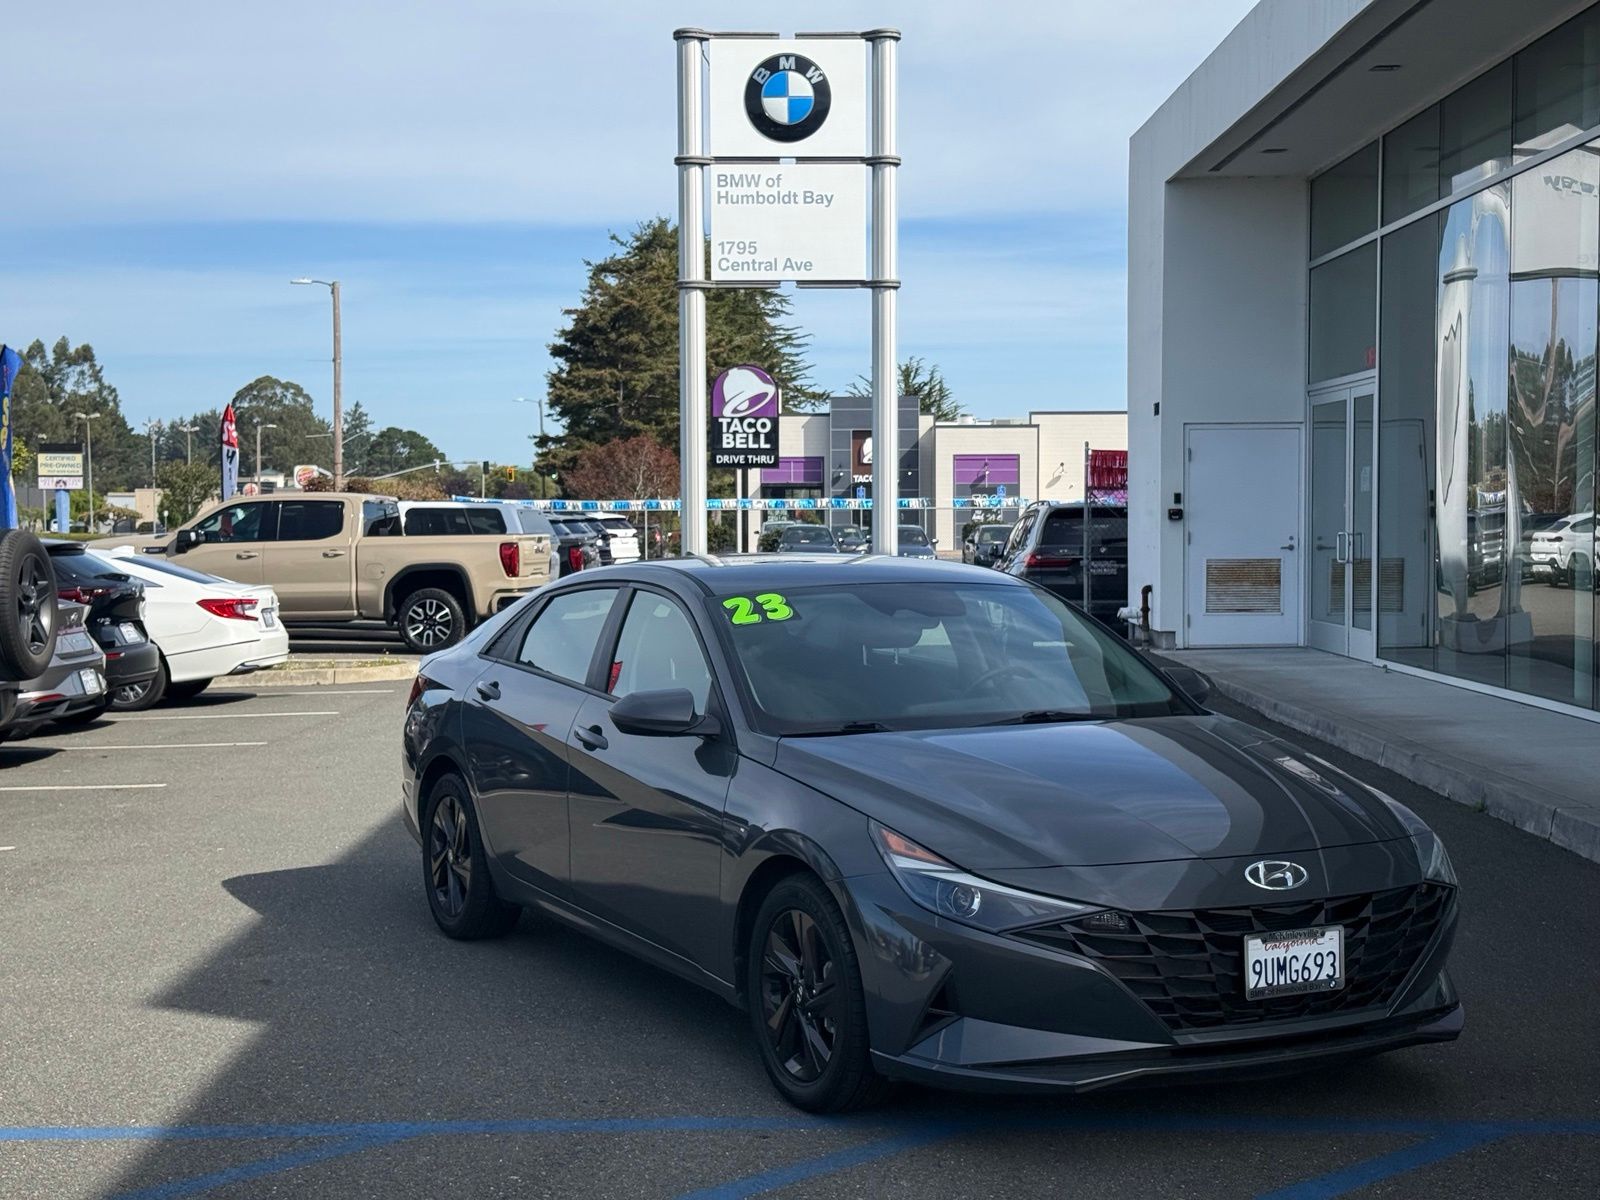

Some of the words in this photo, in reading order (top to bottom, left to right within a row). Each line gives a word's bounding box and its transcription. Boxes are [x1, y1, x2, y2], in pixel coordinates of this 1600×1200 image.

[753, 56, 824, 85] BMW
[716, 174, 761, 188] BMW
[765, 174, 782, 188] of
[716, 190, 799, 205] Humboldt
[803, 191, 834, 207] Bay
[717, 241, 757, 255] 1795
[717, 257, 778, 272] Central
[782, 257, 813, 272] Ave
[718, 418, 772, 433] TACO
[722, 433, 771, 449] BELL
[716, 455, 746, 464] DRIVE
[747, 455, 775, 464] THRU
[723, 593, 794, 625] 23
[1252, 950, 1337, 990] 9UMG693
